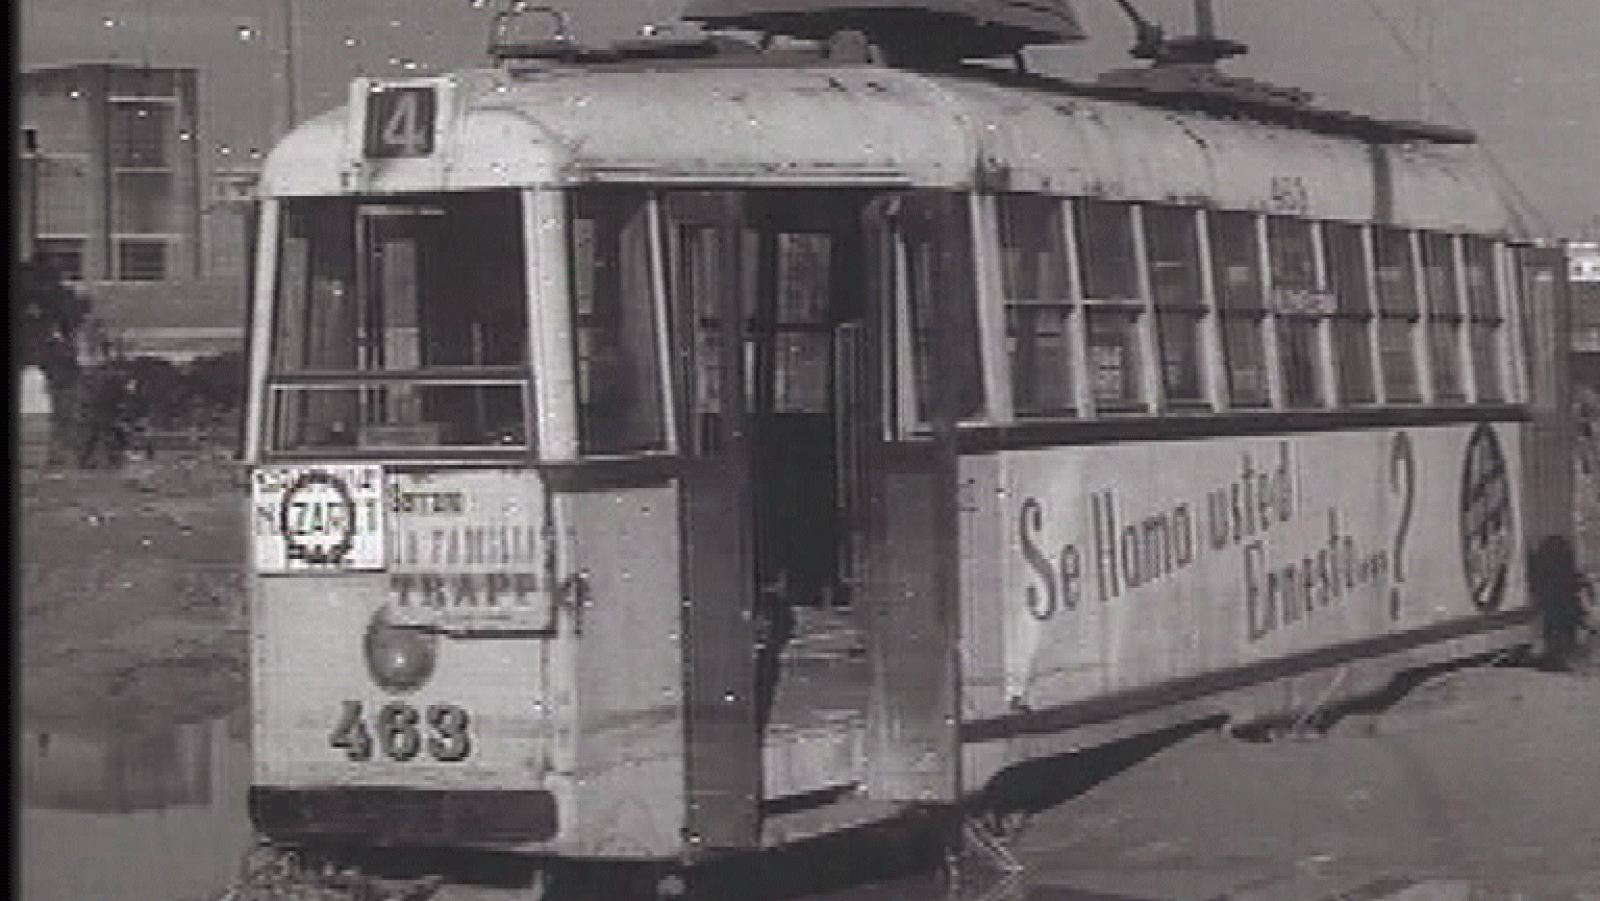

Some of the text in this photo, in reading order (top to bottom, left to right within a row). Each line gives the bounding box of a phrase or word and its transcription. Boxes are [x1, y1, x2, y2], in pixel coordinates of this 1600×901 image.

[383, 91, 428, 150] 4
[1020, 497, 1080, 621] Se
[328, 700, 473, 762] 463
